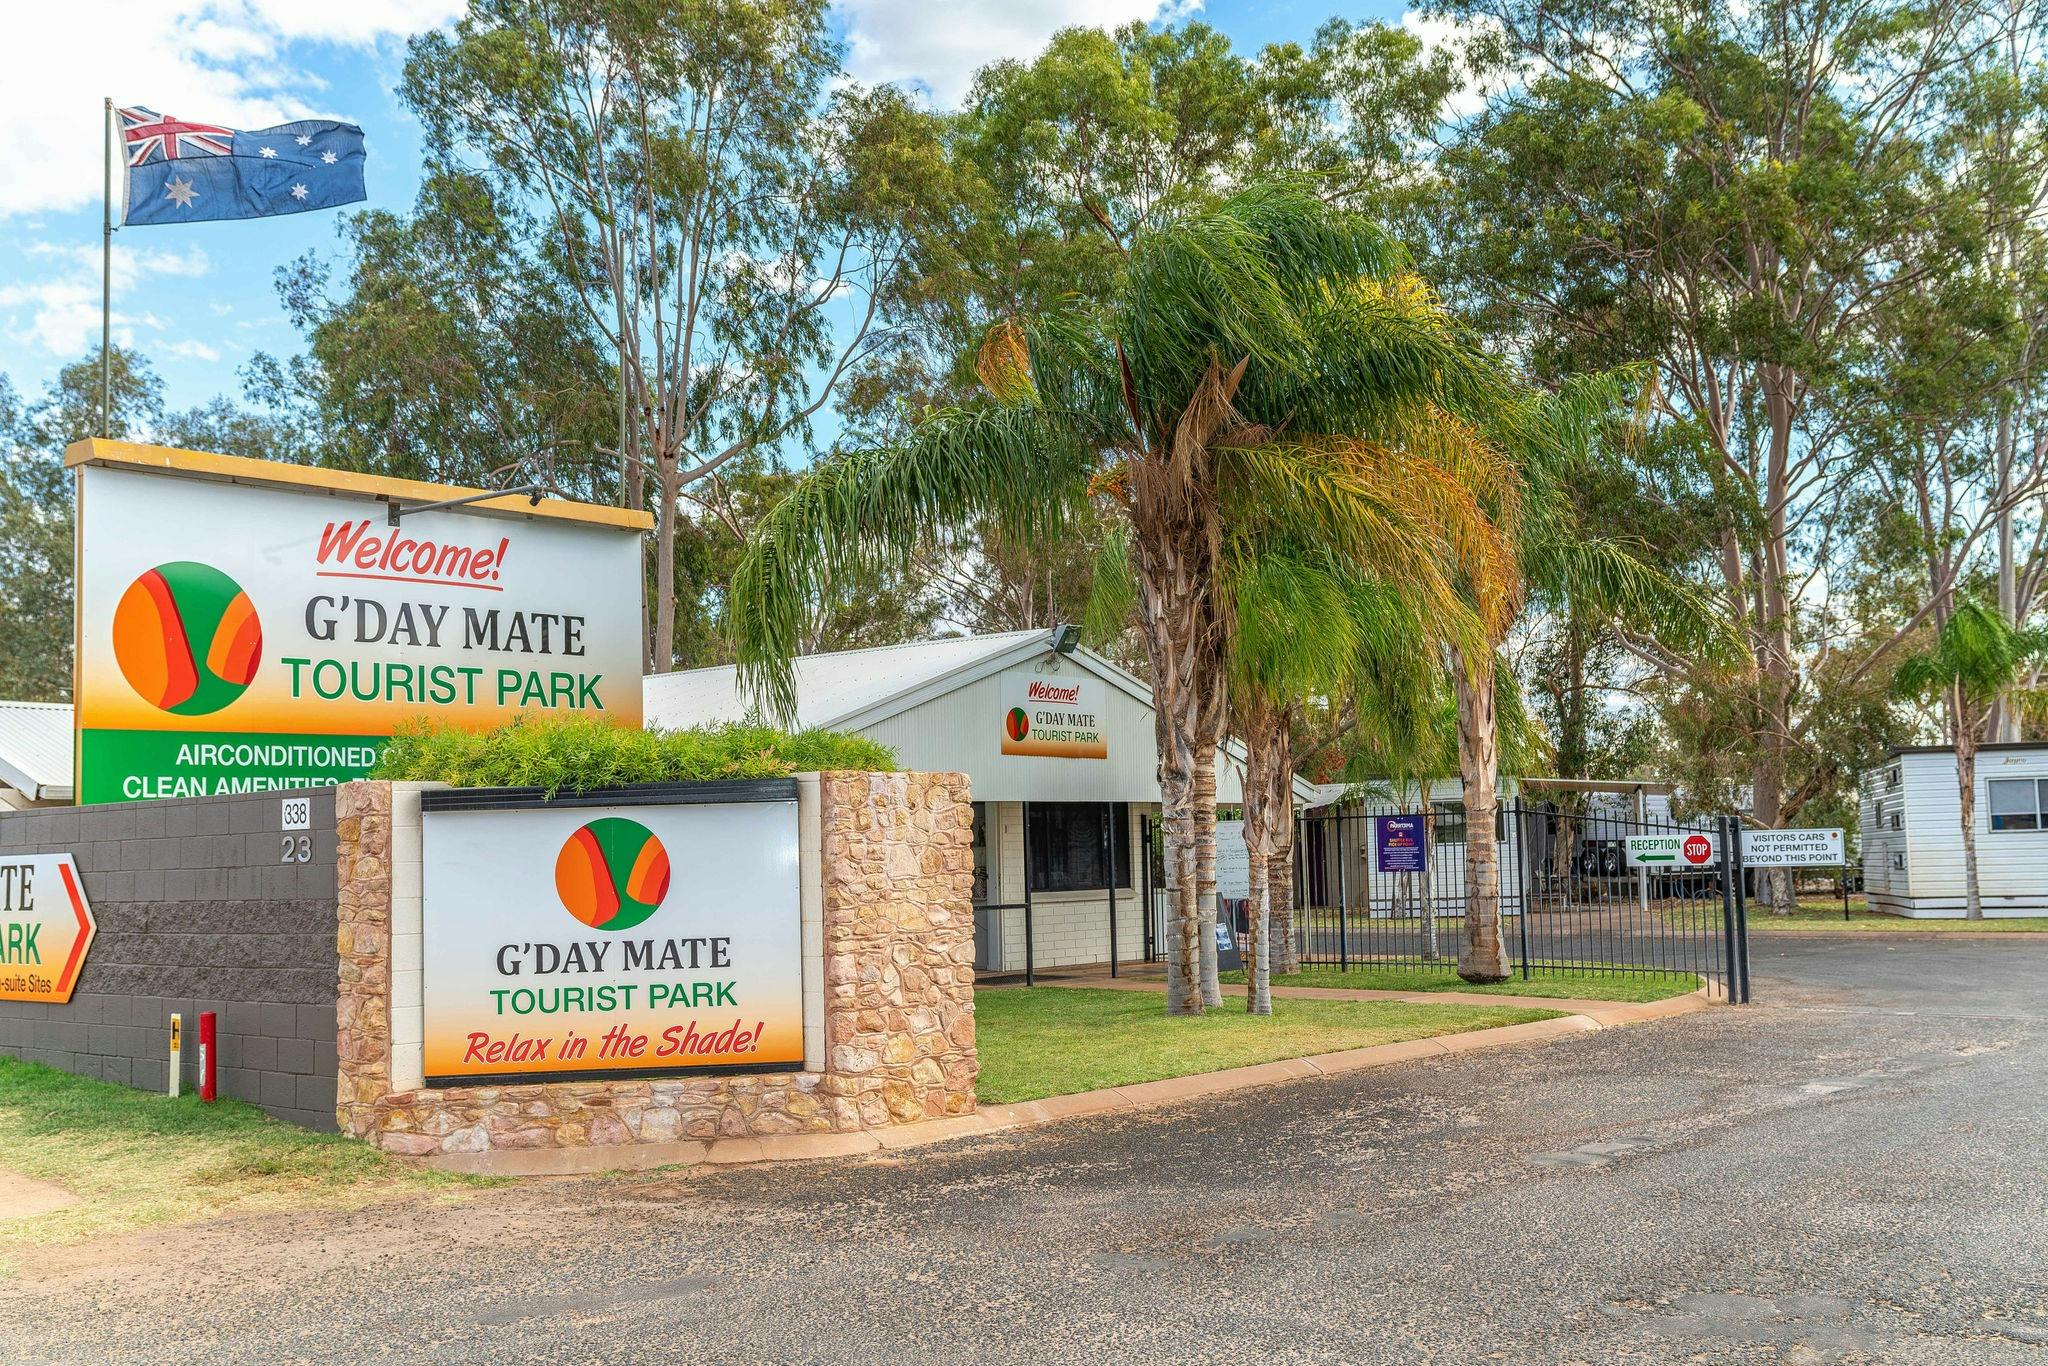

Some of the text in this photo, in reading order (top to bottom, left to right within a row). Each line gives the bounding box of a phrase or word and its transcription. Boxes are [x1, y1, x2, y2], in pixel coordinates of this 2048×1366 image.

[316, 519, 509, 582] Welcome!
[305, 596, 586, 656] G'DAY MATE
[281, 657, 605, 711] TOURIST PARK
[1028, 681, 1080, 701] Welcome!
[1036, 711, 1096, 727] G'DAY MATE
[1032, 729, 1099, 743] TOURIST PARK
[176, 744, 377, 767] AIRCONDITIONED
[122, 776, 206, 798] CLEAN
[285, 803, 307, 825] 338
[1631, 839, 1680, 850] RECEPTION
[1687, 843, 1708, 856] STOP
[1751, 843, 1828, 852] NOT PERMITTED
[1752, 833, 1825, 842] VISITORS CARS
[281, 835, 312, 863] 23
[1743, 853, 1838, 862] BEYOND THIS POINT
[0, 864, 35, 911] TE
[496, 936, 731, 976] G'DAY MATE
[0, 974, 52, 994] -suite Sites
[490, 980, 738, 1015] TOURIST PARK
[462, 1018, 765, 1064] Relax in the Shade!
